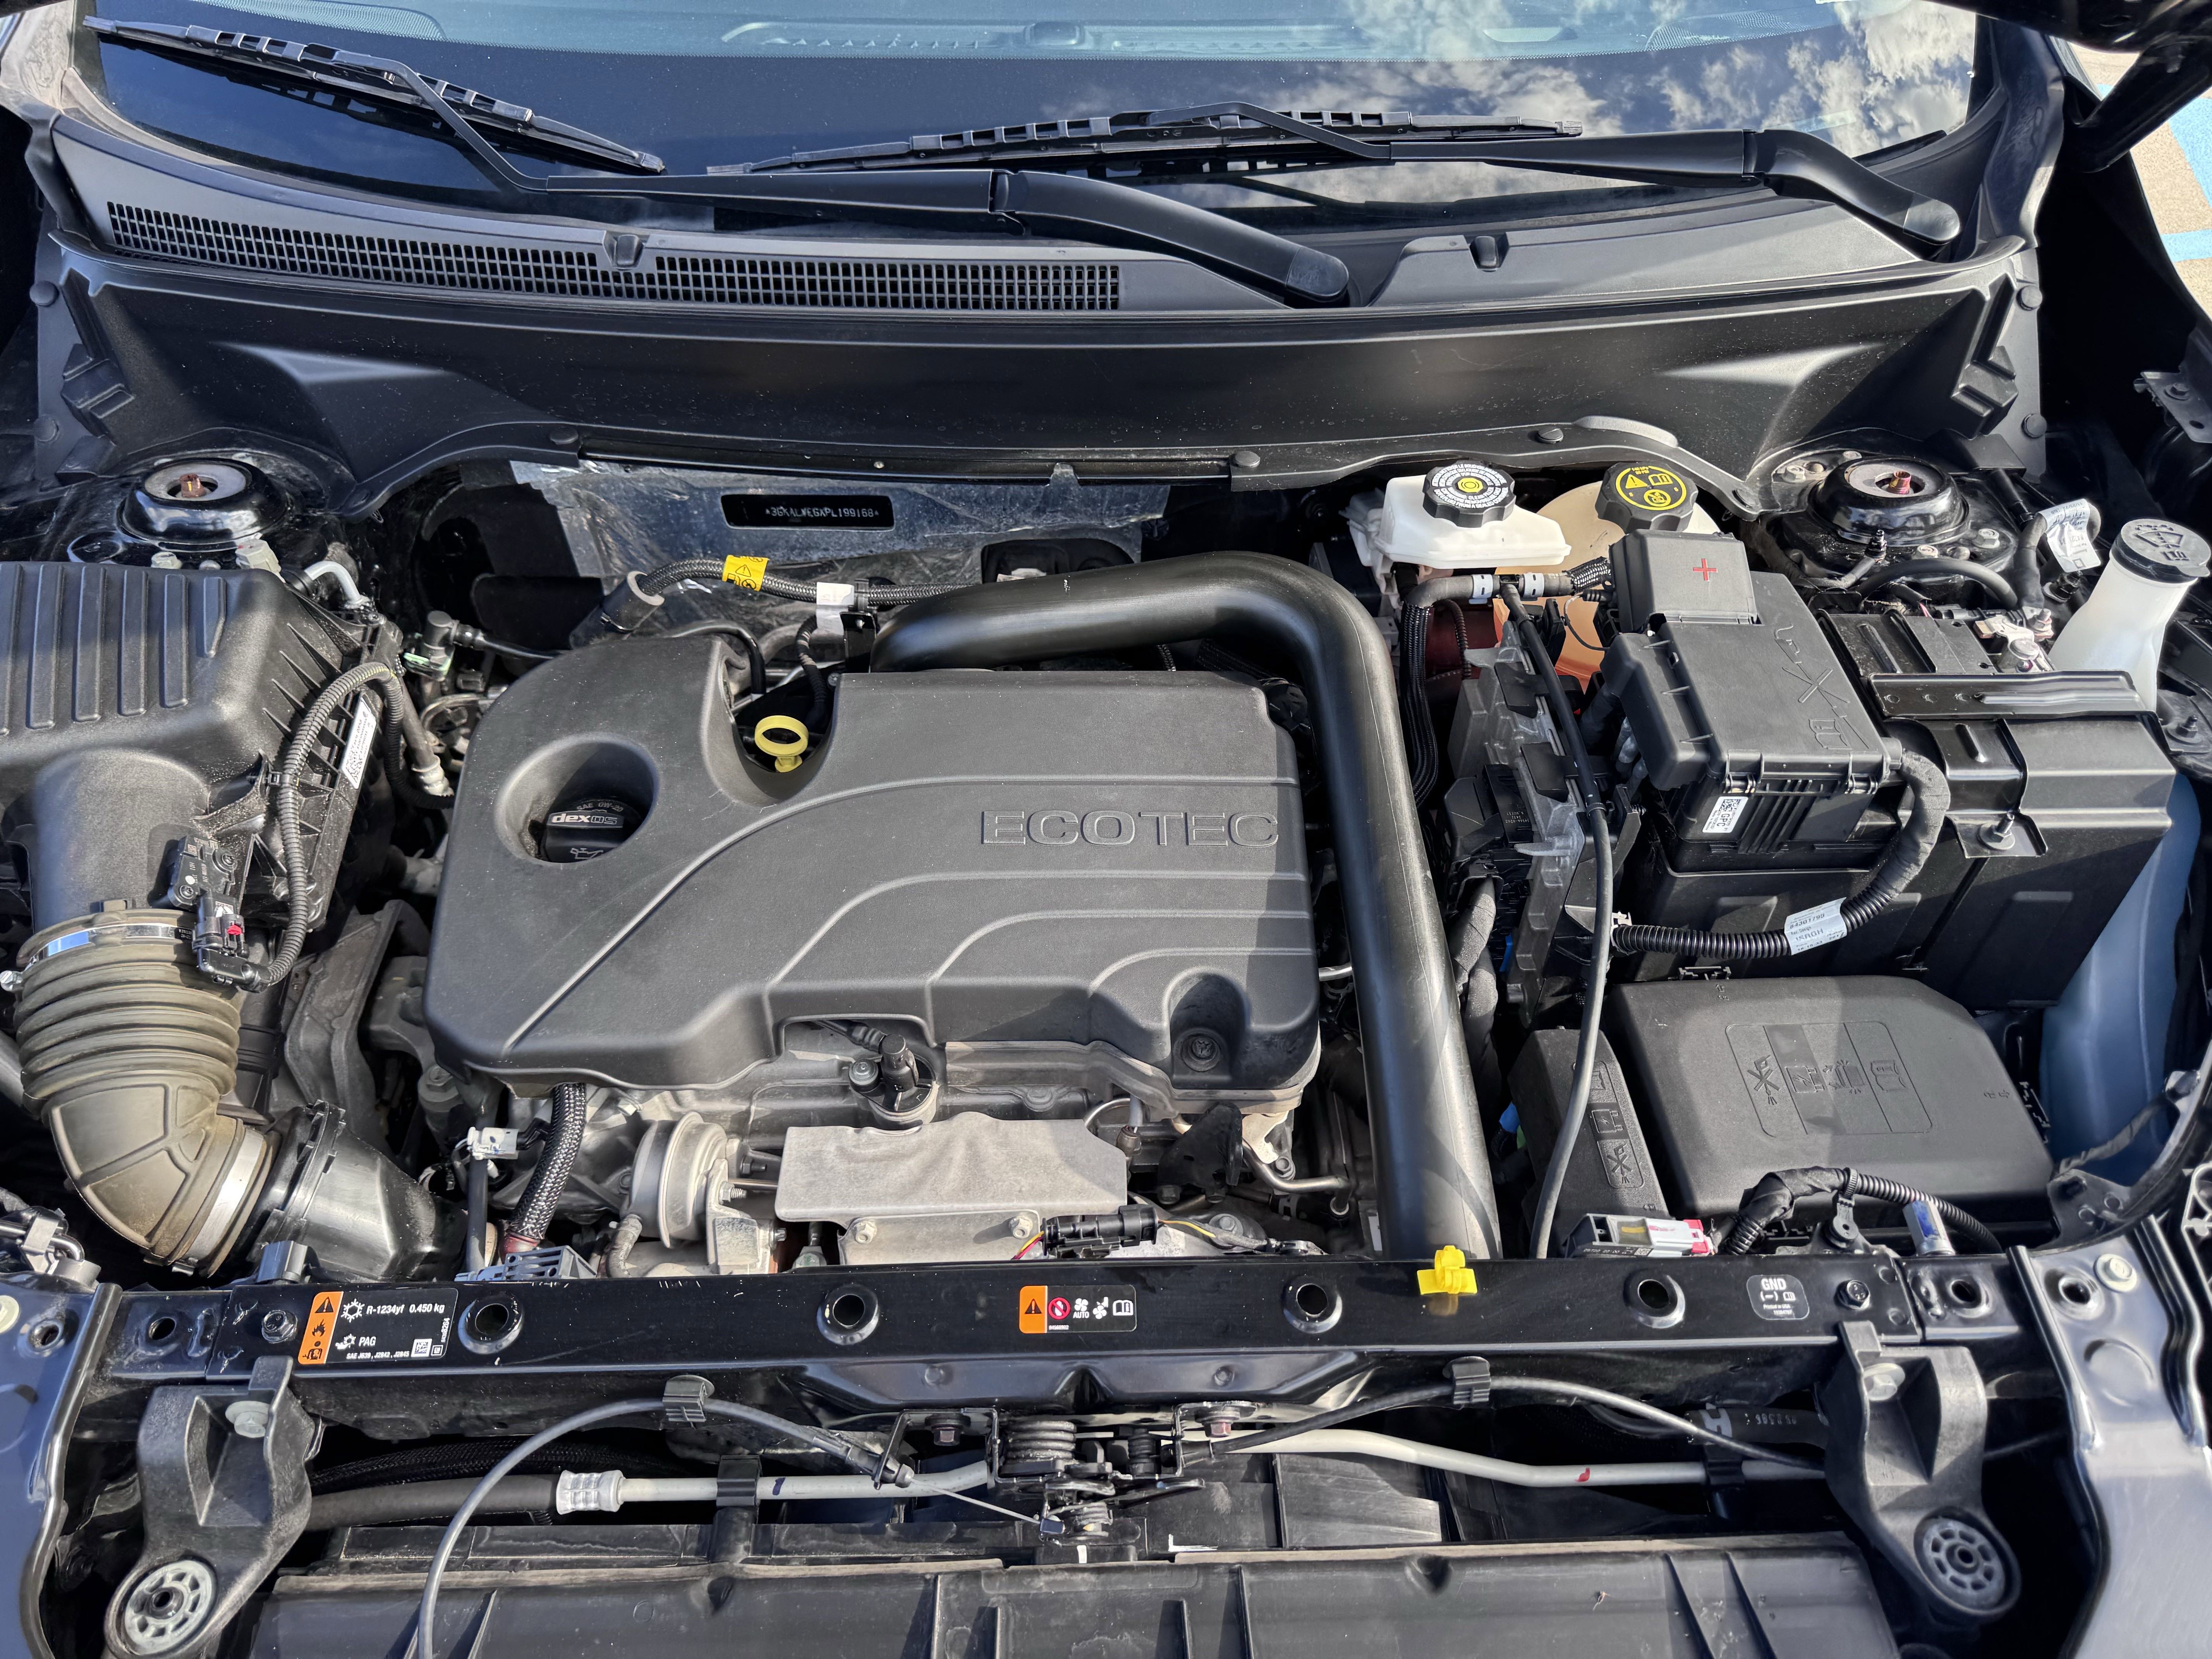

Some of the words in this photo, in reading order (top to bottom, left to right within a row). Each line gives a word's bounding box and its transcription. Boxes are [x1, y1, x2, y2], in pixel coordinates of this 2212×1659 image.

[552, 813, 618, 825] dexos
[981, 810, 1279, 847] ECOTEC
[1761, 1278, 1787, 1291] GND
[366, 1304, 405, 1315] R-1234yf
[409, 1304, 433, 1313] 0.450
[434, 1303, 445, 1314] kg
[359, 1336, 376, 1347] PAG
